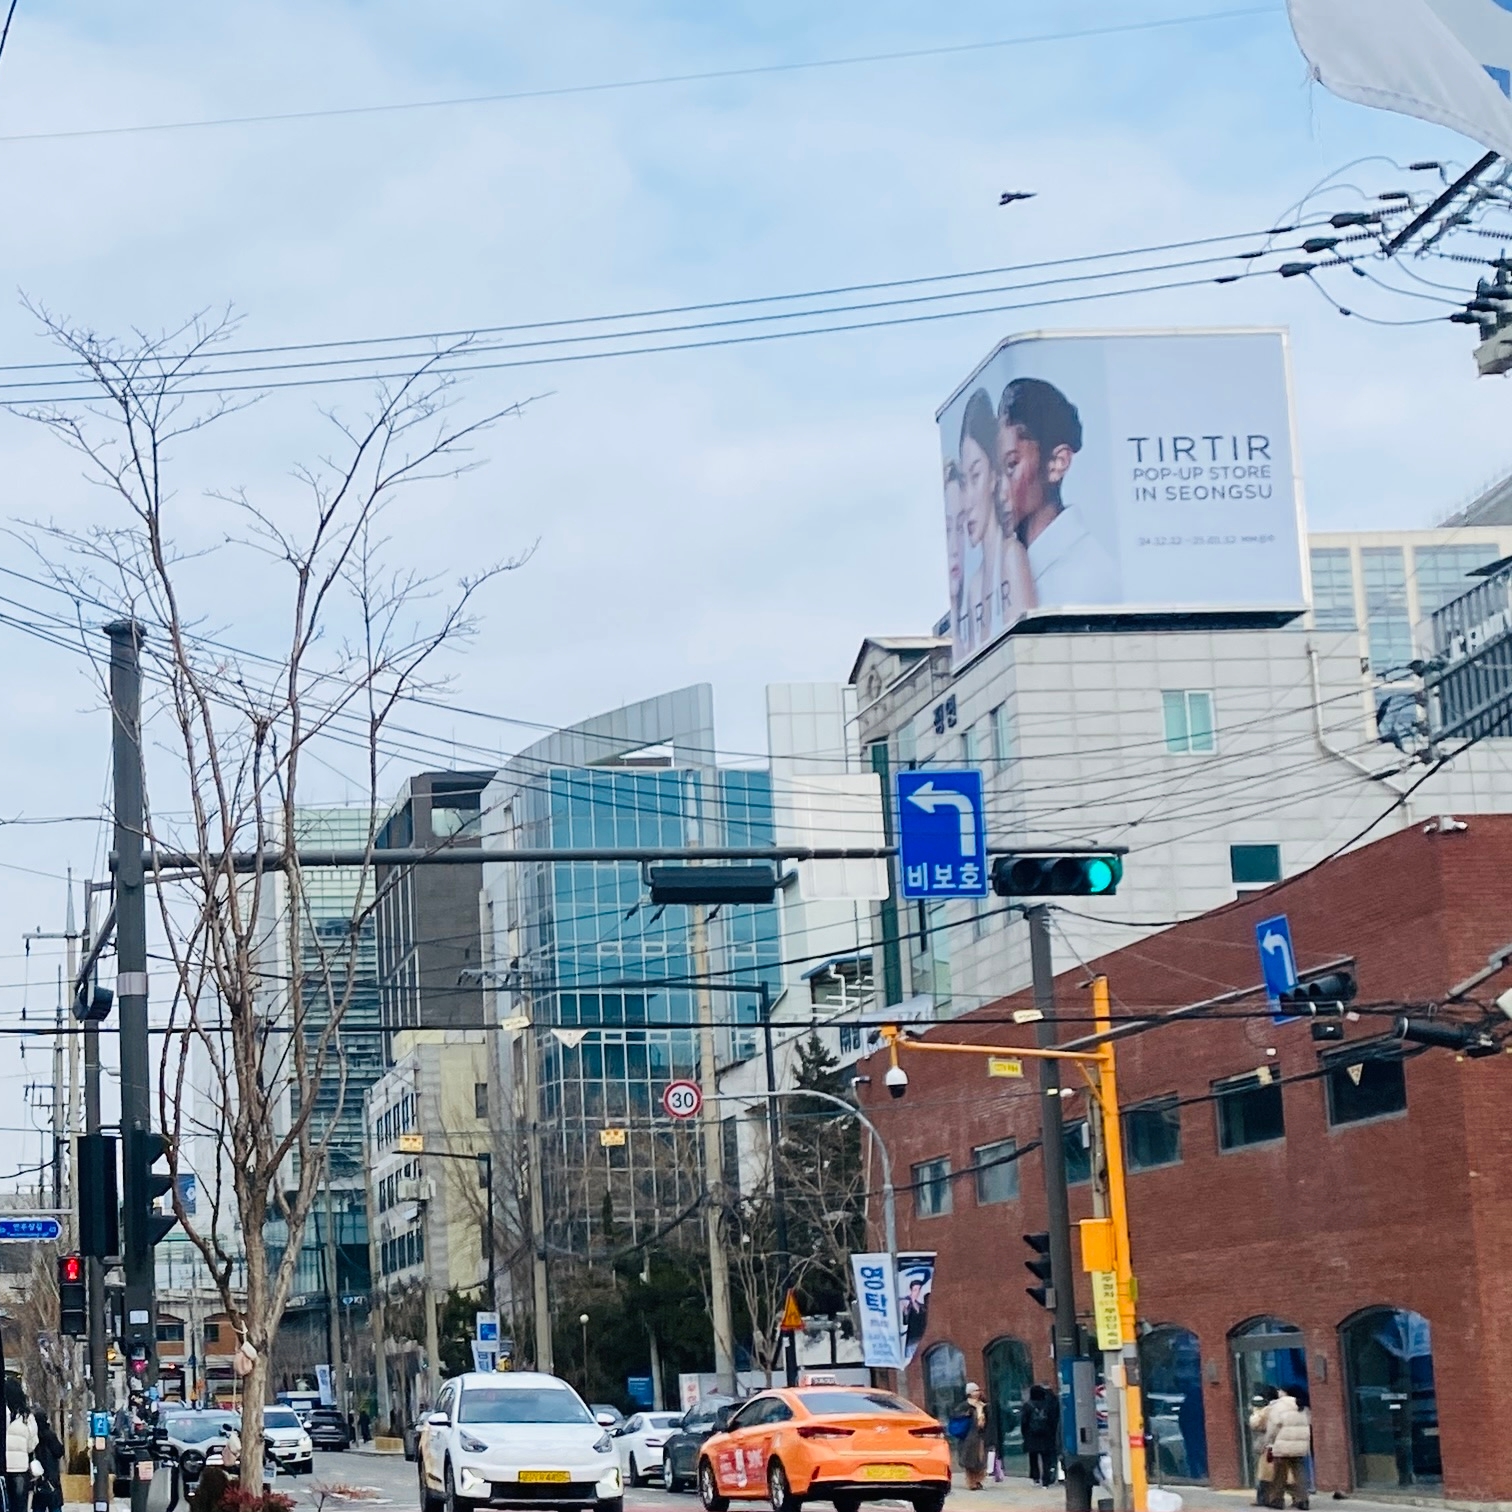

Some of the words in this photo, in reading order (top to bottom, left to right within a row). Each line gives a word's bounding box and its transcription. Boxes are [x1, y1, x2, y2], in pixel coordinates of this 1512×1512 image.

[1127, 434, 1272, 463] TIRTIR
[1133, 466, 1204, 481] POP-UP
[1210, 464, 1272, 481] STORE
[1135, 486, 1157, 501] IN
[1165, 483, 1273, 501] SEONGSU
[907, 864, 983, 891] 비보호
[672, 1092, 693, 1108] 30
